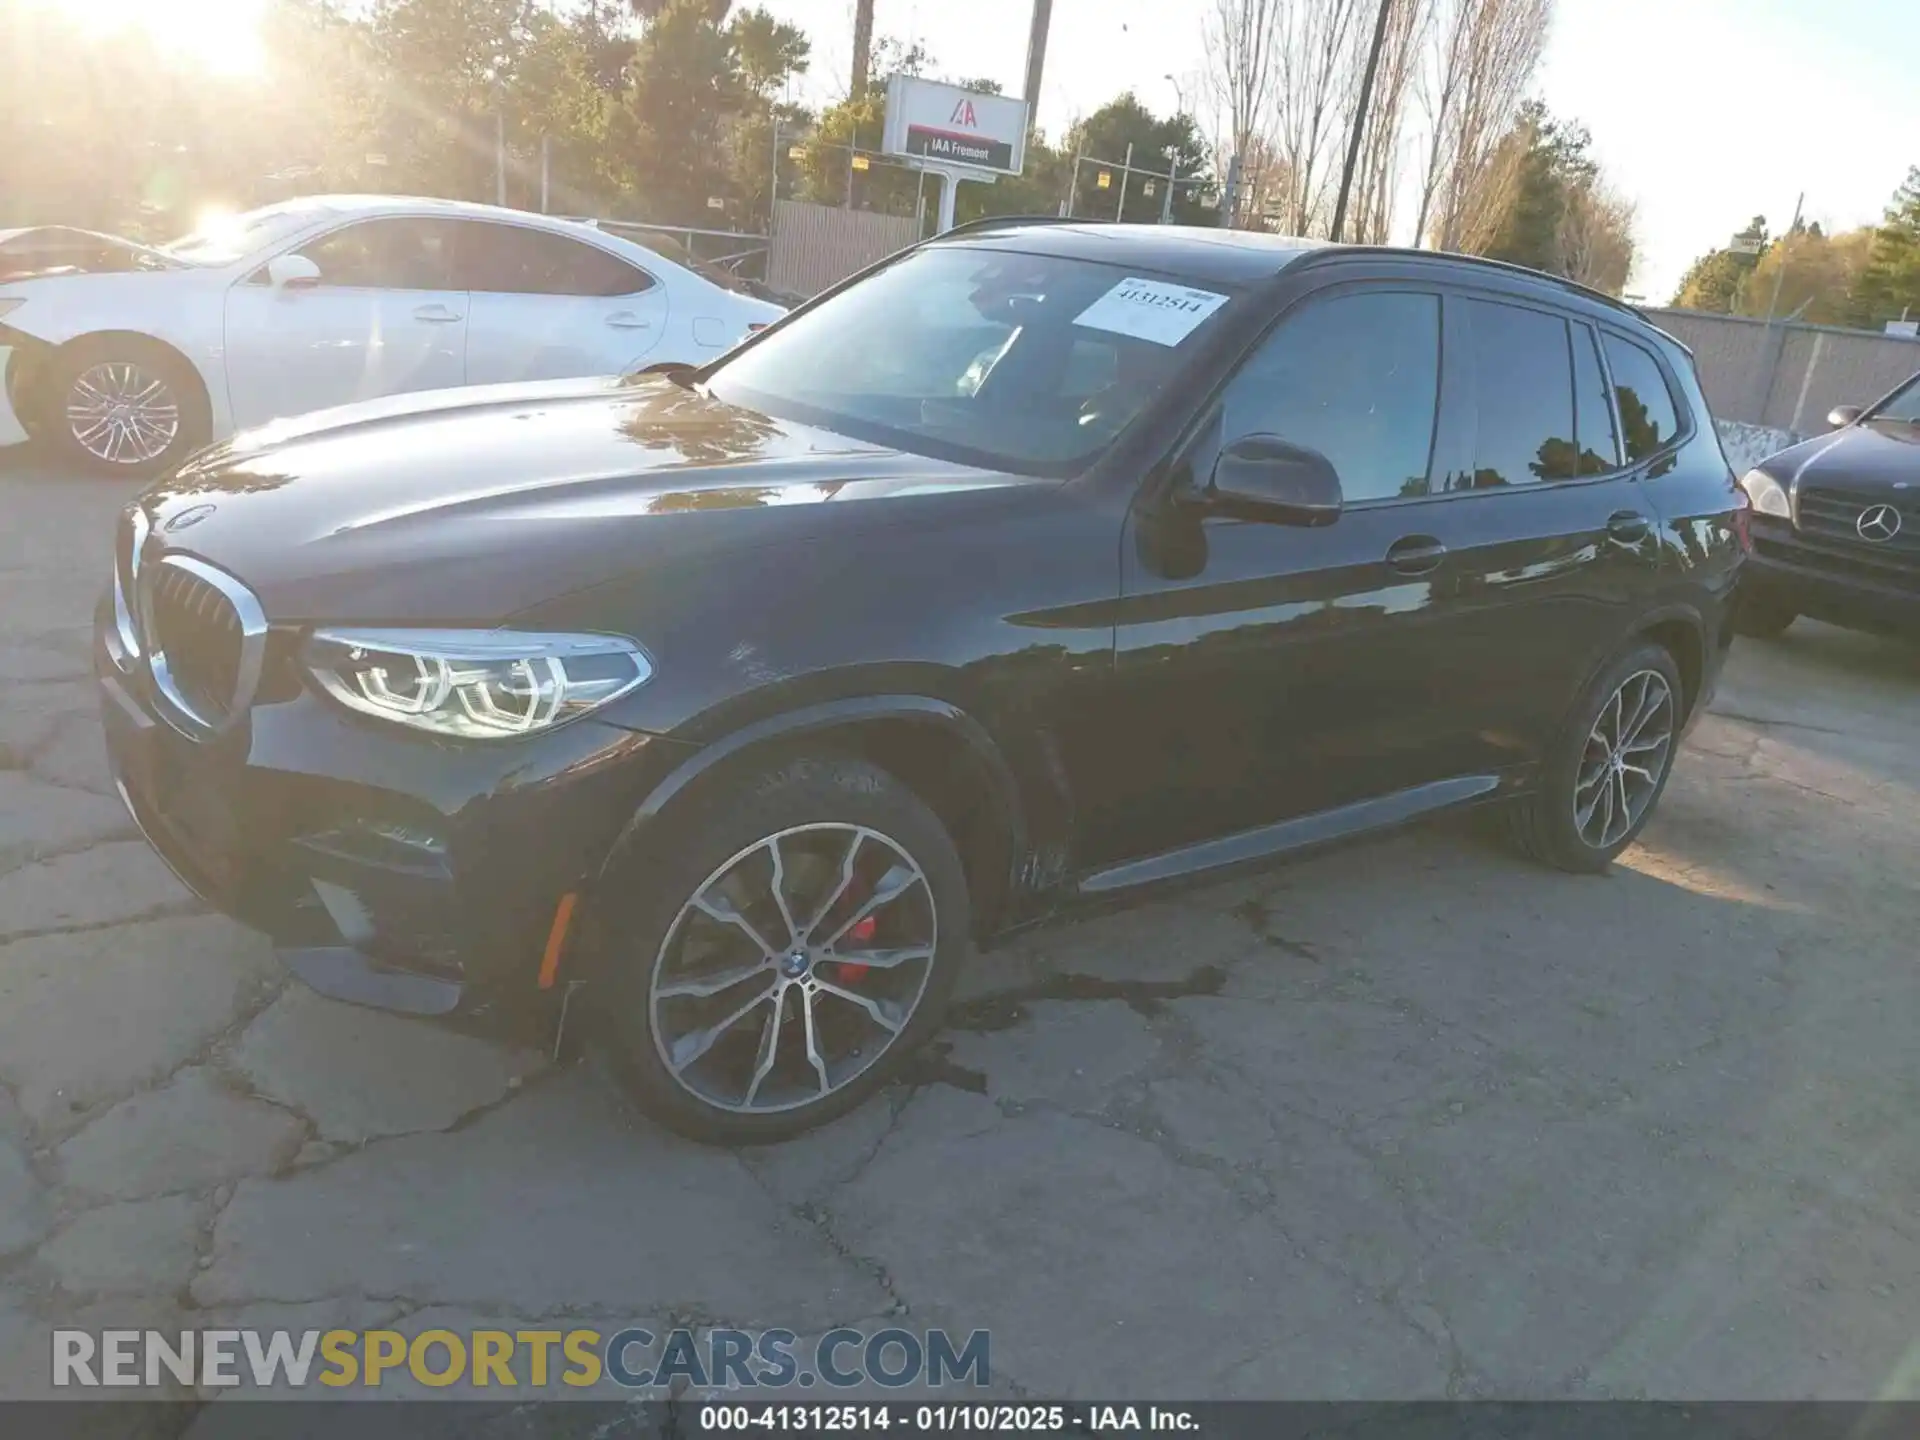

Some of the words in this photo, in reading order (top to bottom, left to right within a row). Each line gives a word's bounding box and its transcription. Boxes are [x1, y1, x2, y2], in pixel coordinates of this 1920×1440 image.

[932, 137, 950, 152] IAA
[951, 141, 989, 161] Fremont
[1118, 289, 1203, 313] 41312514
